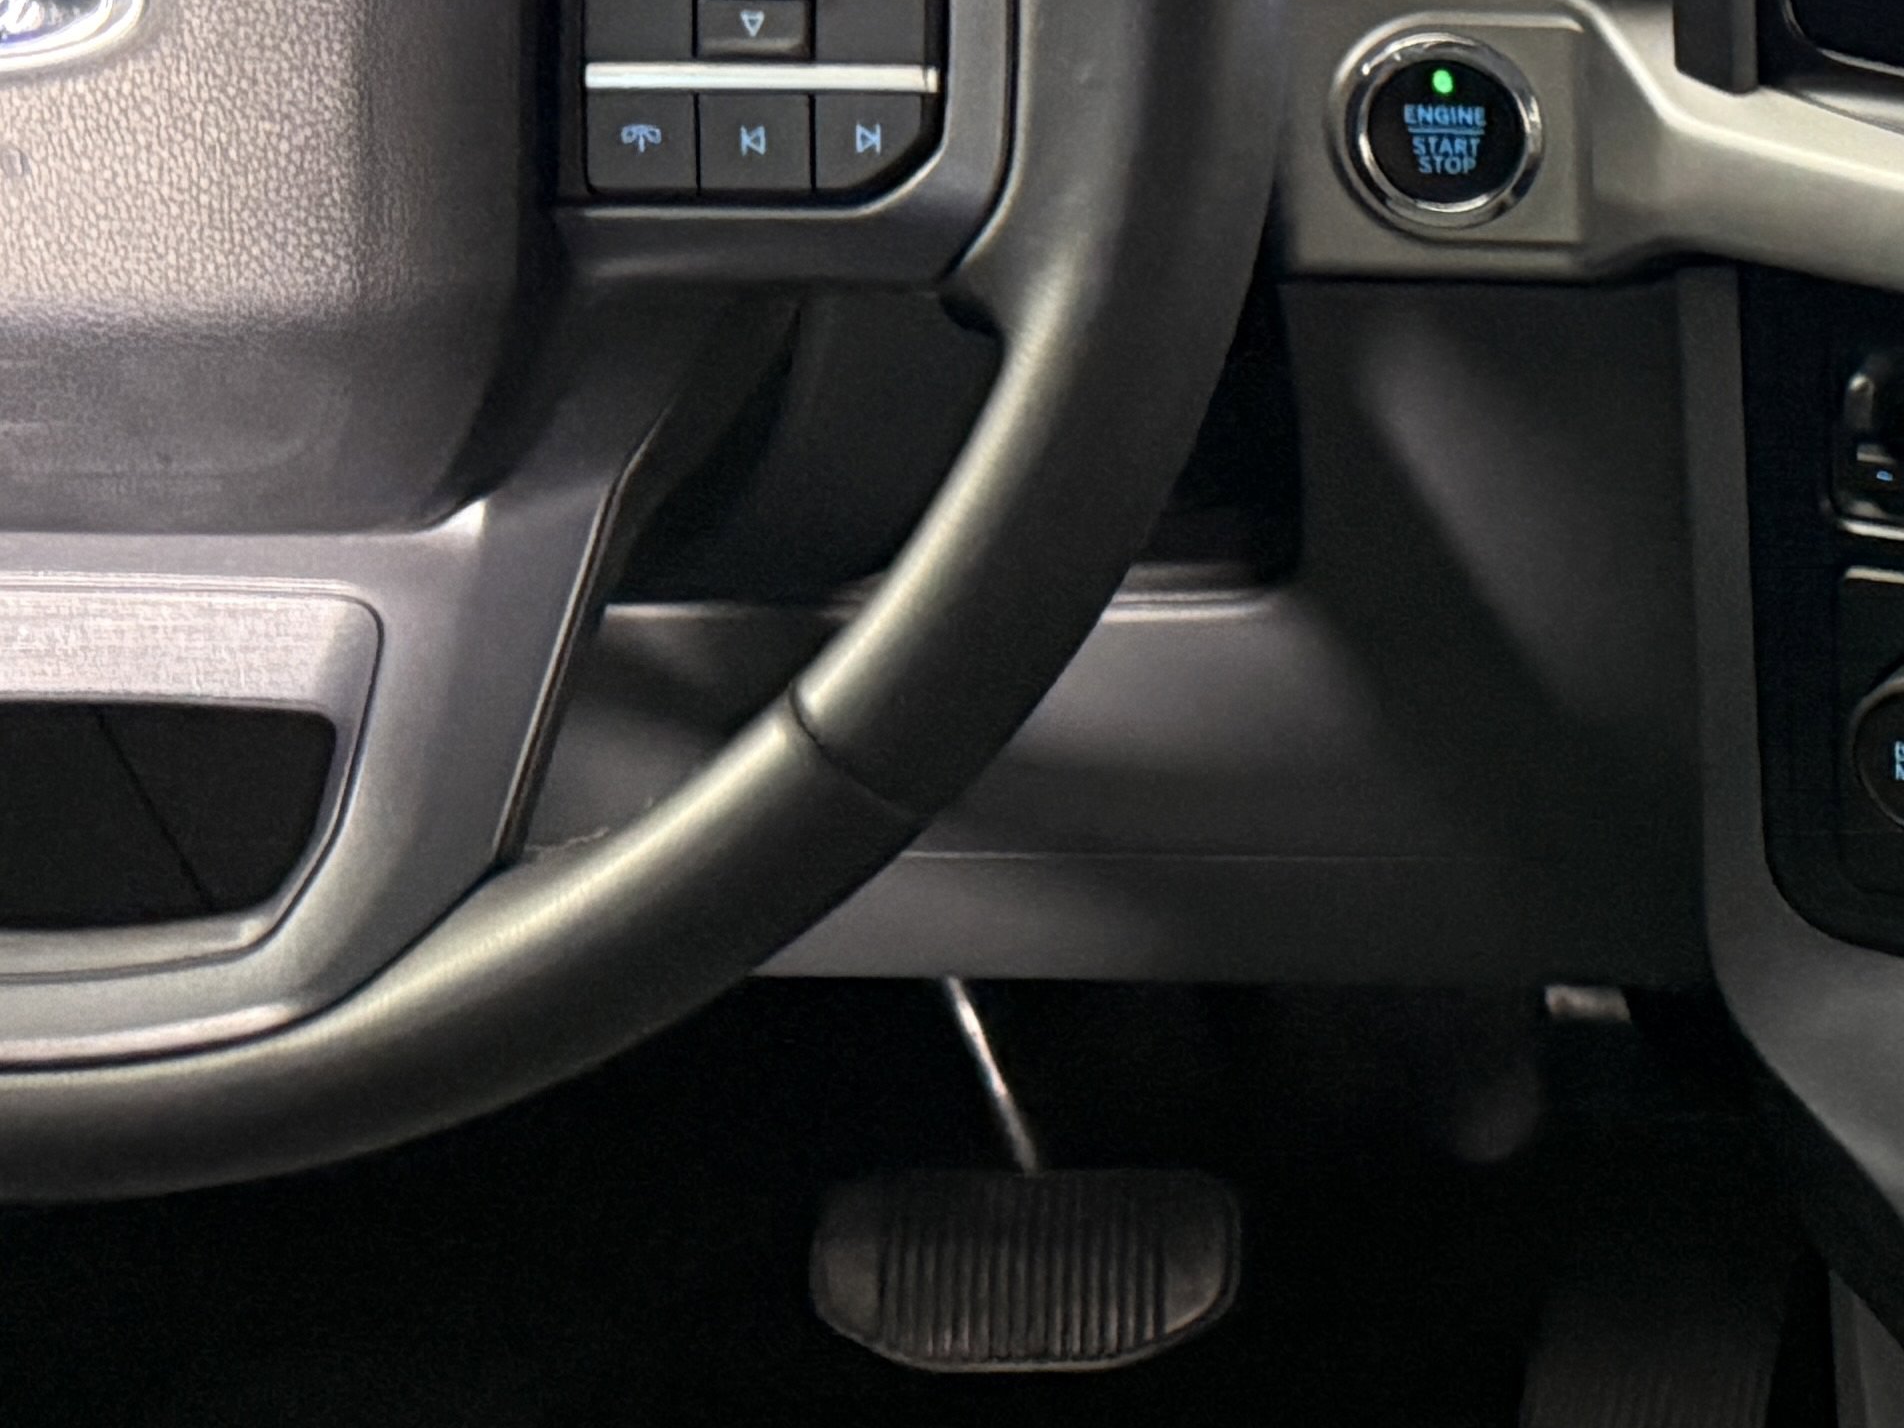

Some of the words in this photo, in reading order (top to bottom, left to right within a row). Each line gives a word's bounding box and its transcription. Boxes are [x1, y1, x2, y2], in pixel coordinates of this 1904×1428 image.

[1404, 104, 1486, 128] ENGINE
[1412, 136, 1481, 158] START
[1418, 156, 1477, 175] STOP
